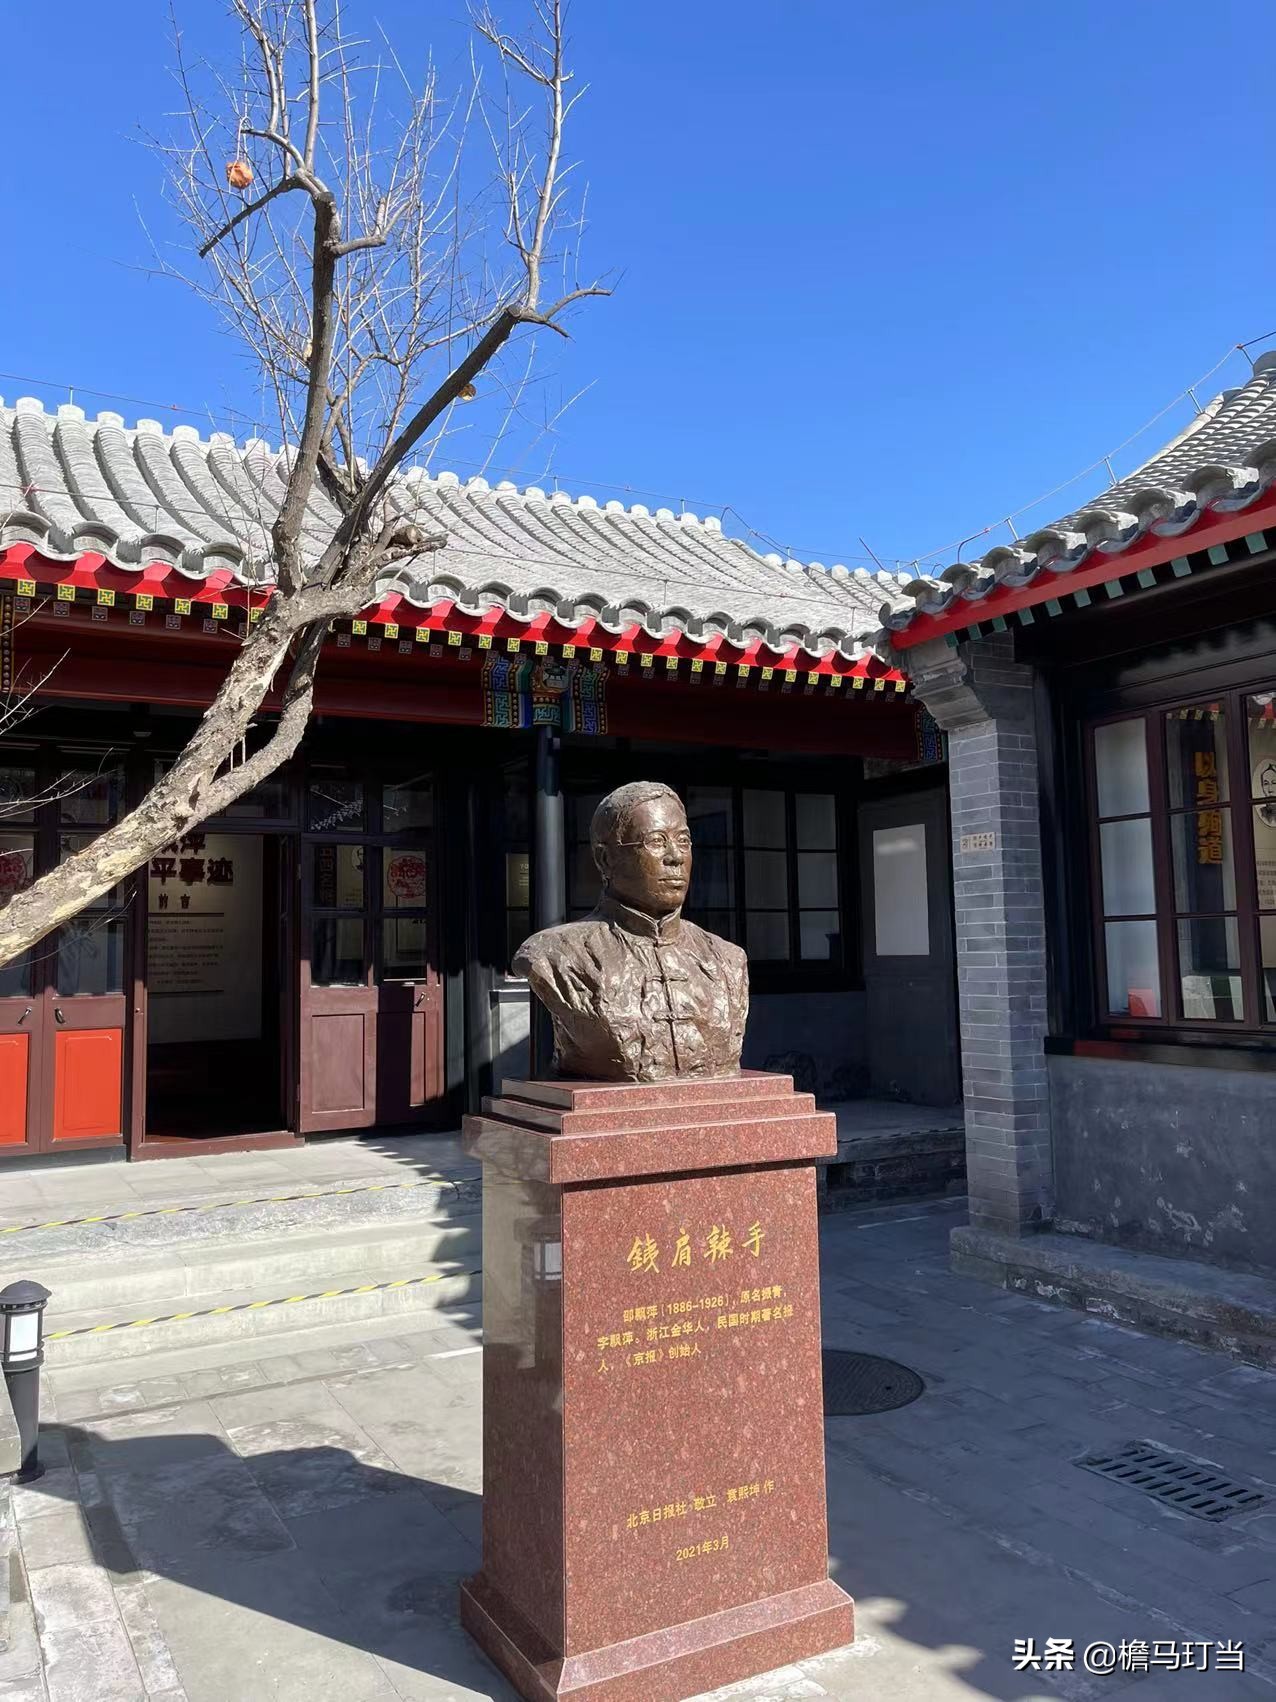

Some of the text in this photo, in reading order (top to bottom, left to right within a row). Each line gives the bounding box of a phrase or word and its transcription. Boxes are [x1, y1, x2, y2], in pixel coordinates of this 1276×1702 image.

[626, 1500, 688, 1529] 北京日报社
[676, 1535, 730, 1562] 2021年3月
